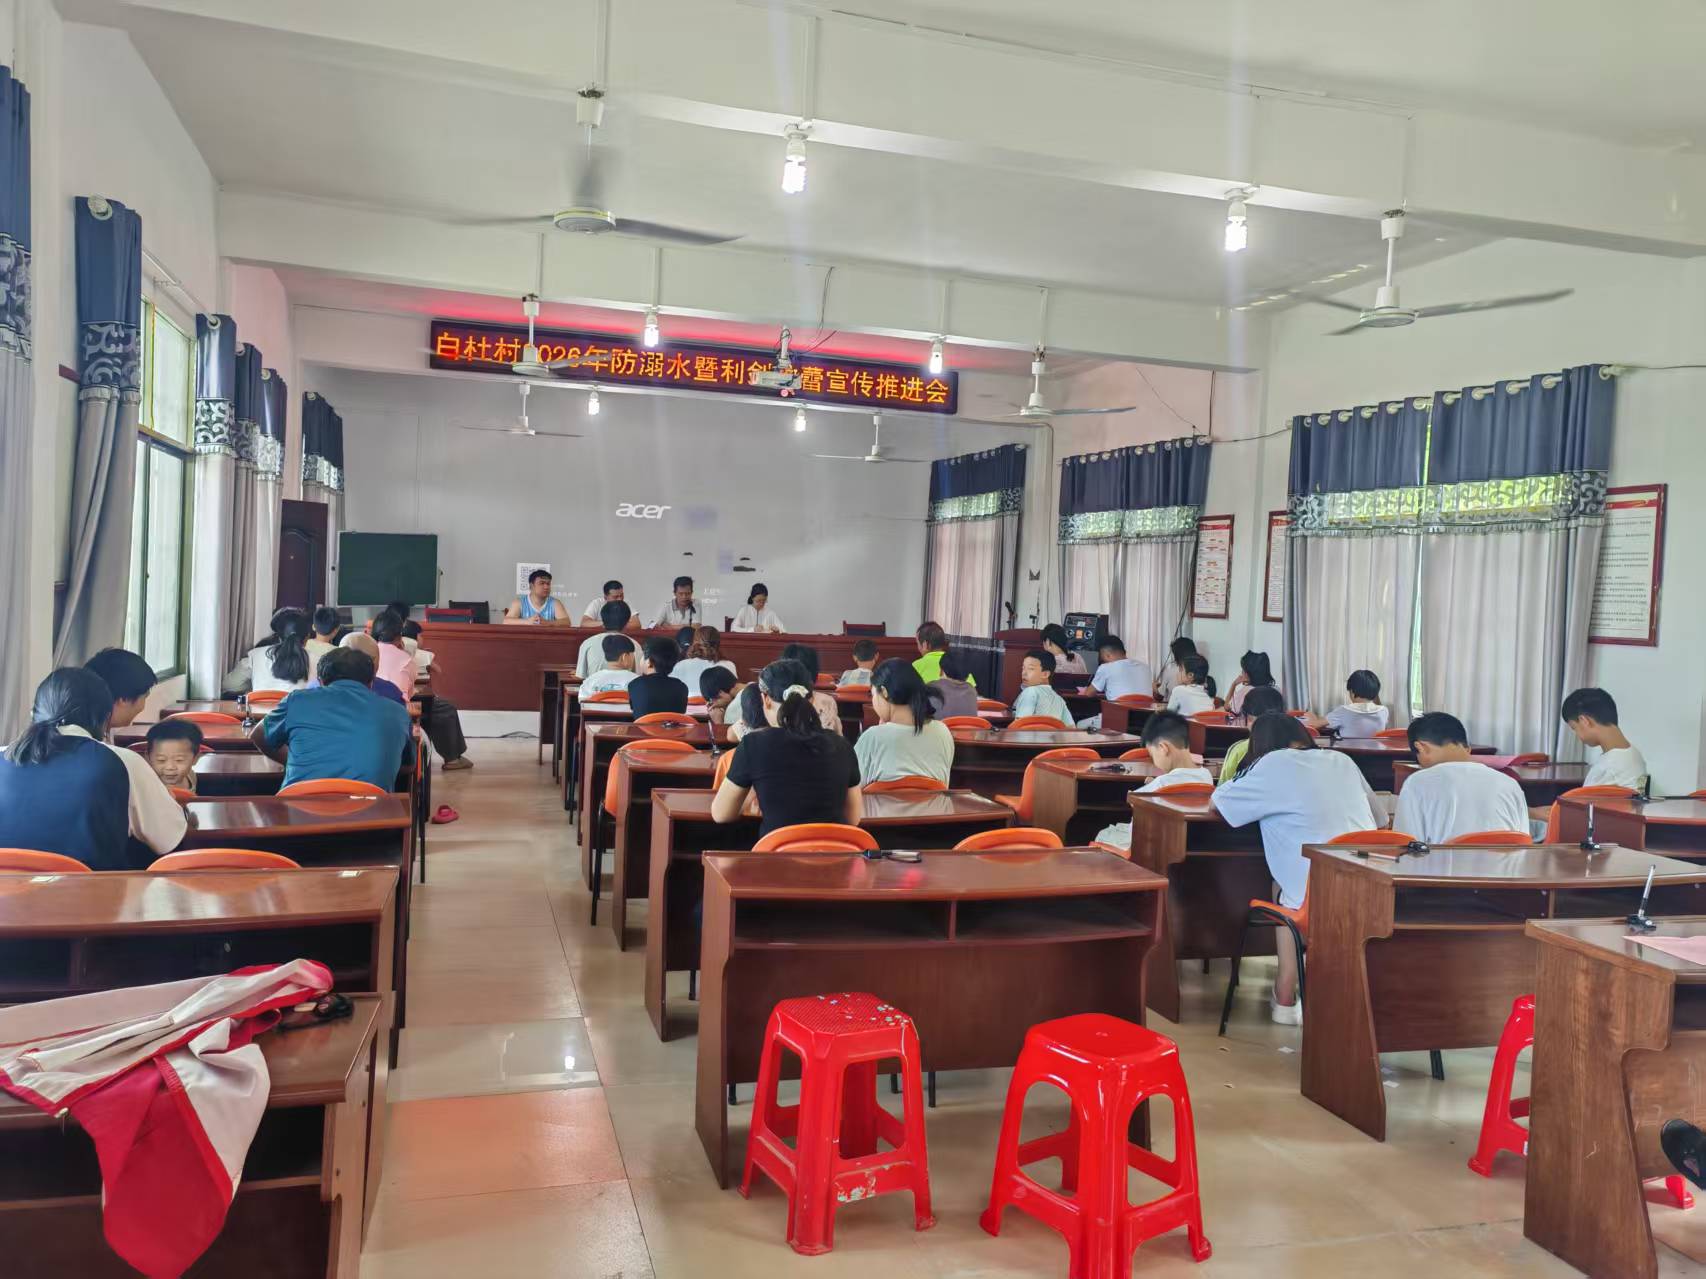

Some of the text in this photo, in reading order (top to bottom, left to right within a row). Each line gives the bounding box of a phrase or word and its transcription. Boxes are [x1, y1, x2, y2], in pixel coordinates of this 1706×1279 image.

[437, 332, 949, 403] 白杜村026年防溺水暨利蕾宣传推进会
[615, 502, 672, 519] acer
